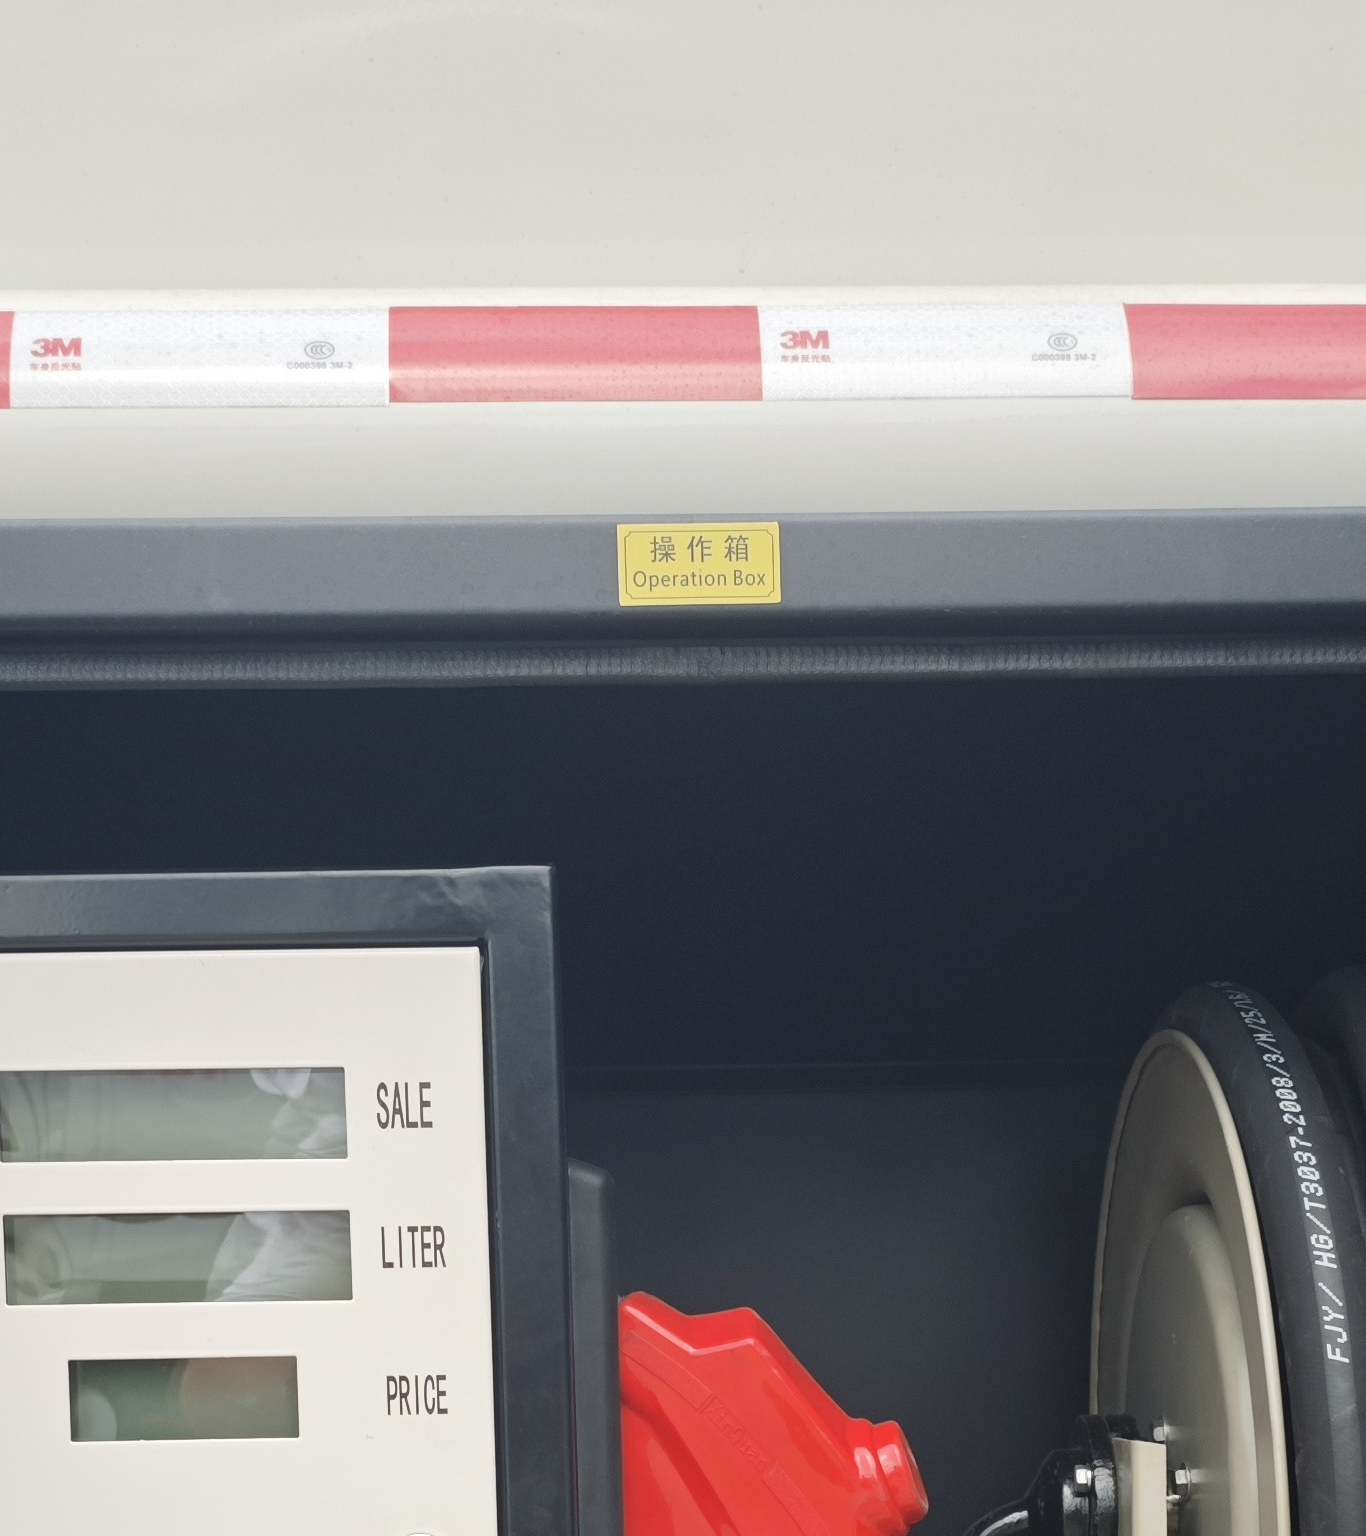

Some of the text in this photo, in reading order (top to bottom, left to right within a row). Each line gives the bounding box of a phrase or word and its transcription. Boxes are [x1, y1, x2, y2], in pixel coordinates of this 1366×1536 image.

[30, 337, 82, 358] 3M
[780, 330, 830, 350] 3M
[286, 361, 327, 370] C000398
[1032, 353, 1071, 362] C000398
[649, 535, 750, 563] 操作箱
[633, 569, 766, 592] Operation Box
[376, 1082, 434, 1129] SALE
[381, 1225, 447, 1269] LITER
[1318, 1282, 1350, 1363] FJY/
[386, 1374, 448, 1416] PRICE
